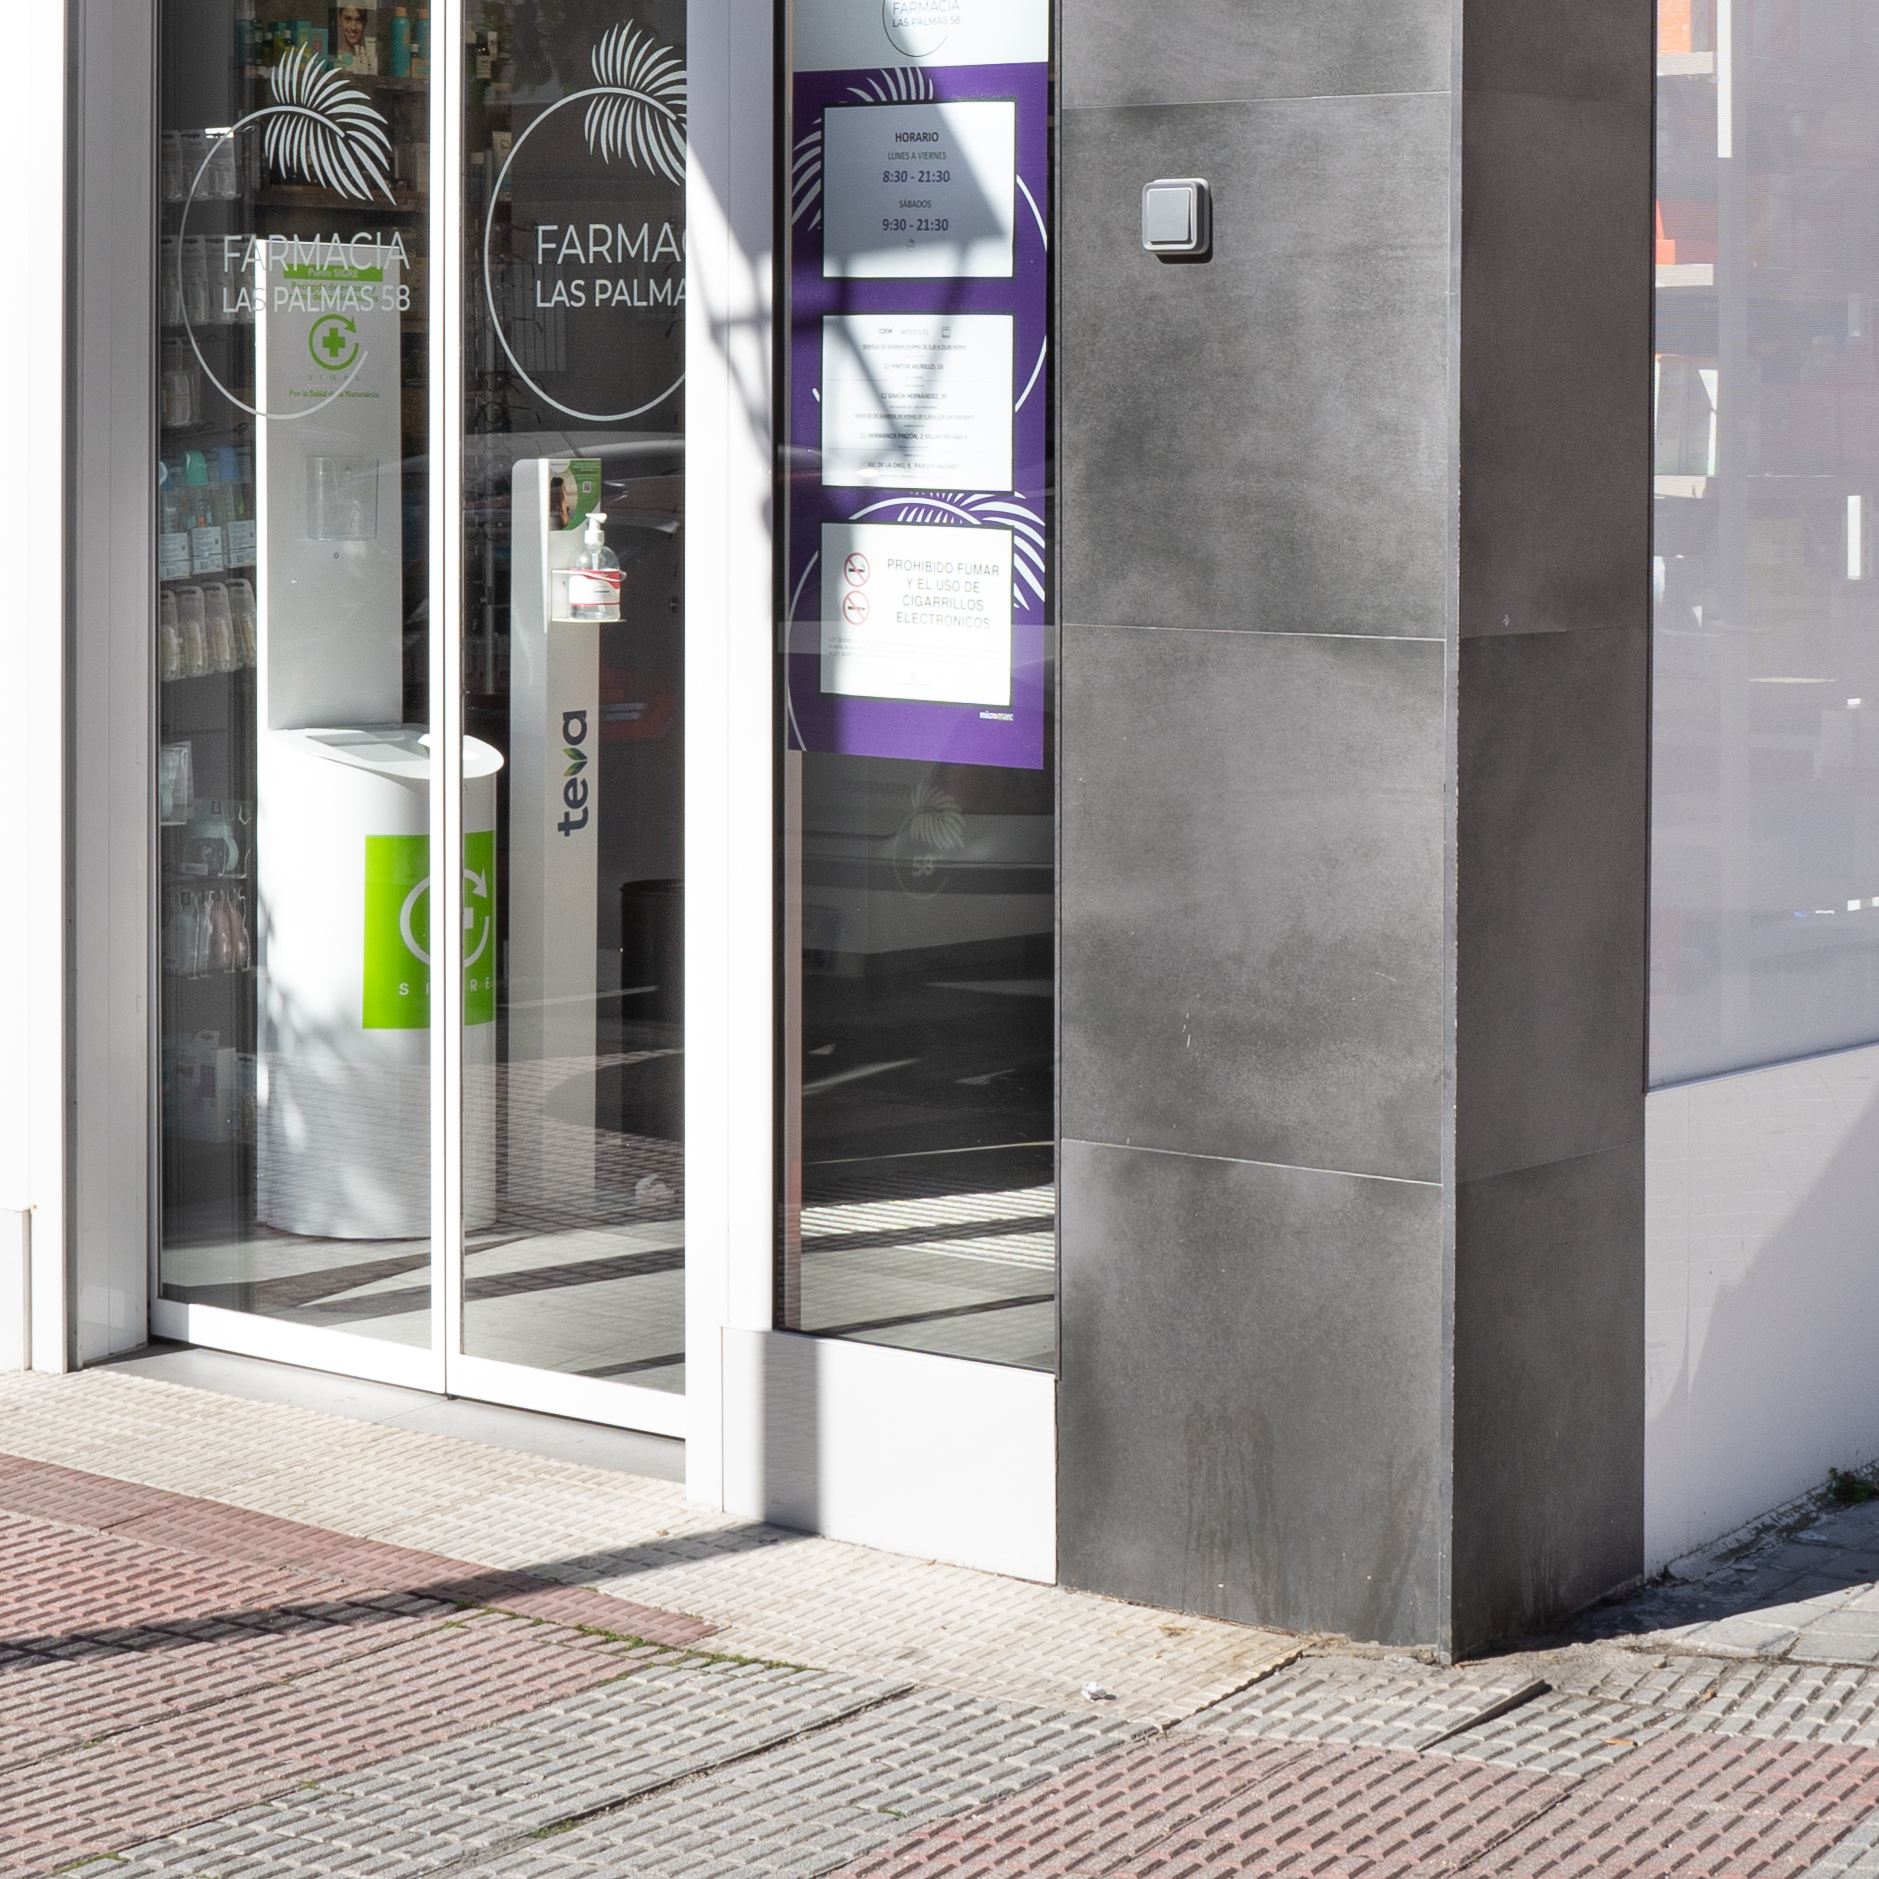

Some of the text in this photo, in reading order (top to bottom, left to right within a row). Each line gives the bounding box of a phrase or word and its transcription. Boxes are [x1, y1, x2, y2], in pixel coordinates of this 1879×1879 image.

[892, 0, 961, 16] FARMACIA
[892, 15, 961, 28] LAS PALMAS 58
[895, 131, 939, 144] HORARIO
[887, 151, 910, 161] LUNES
[917, 150, 947, 161] VIERNES
[882, 169, 950, 184] 8:30 21:30
[899, 197, 932, 209] SÁBADOS
[882, 217, 949, 232] 9:30 21:30
[536, 222, 686, 265] FARMA
[223, 232, 410, 272] FARMACIA
[222, 283, 411, 313] LAS PALMAS 58
[536, 281, 586, 307] LAS
[887, 558, 1000, 576] PROHIBIDO FUMAR
[907, 578, 980, 593] Y EL USO DE
[902, 594, 984, 612] CIGARRILLOS
[558, 709, 589, 837] teva
